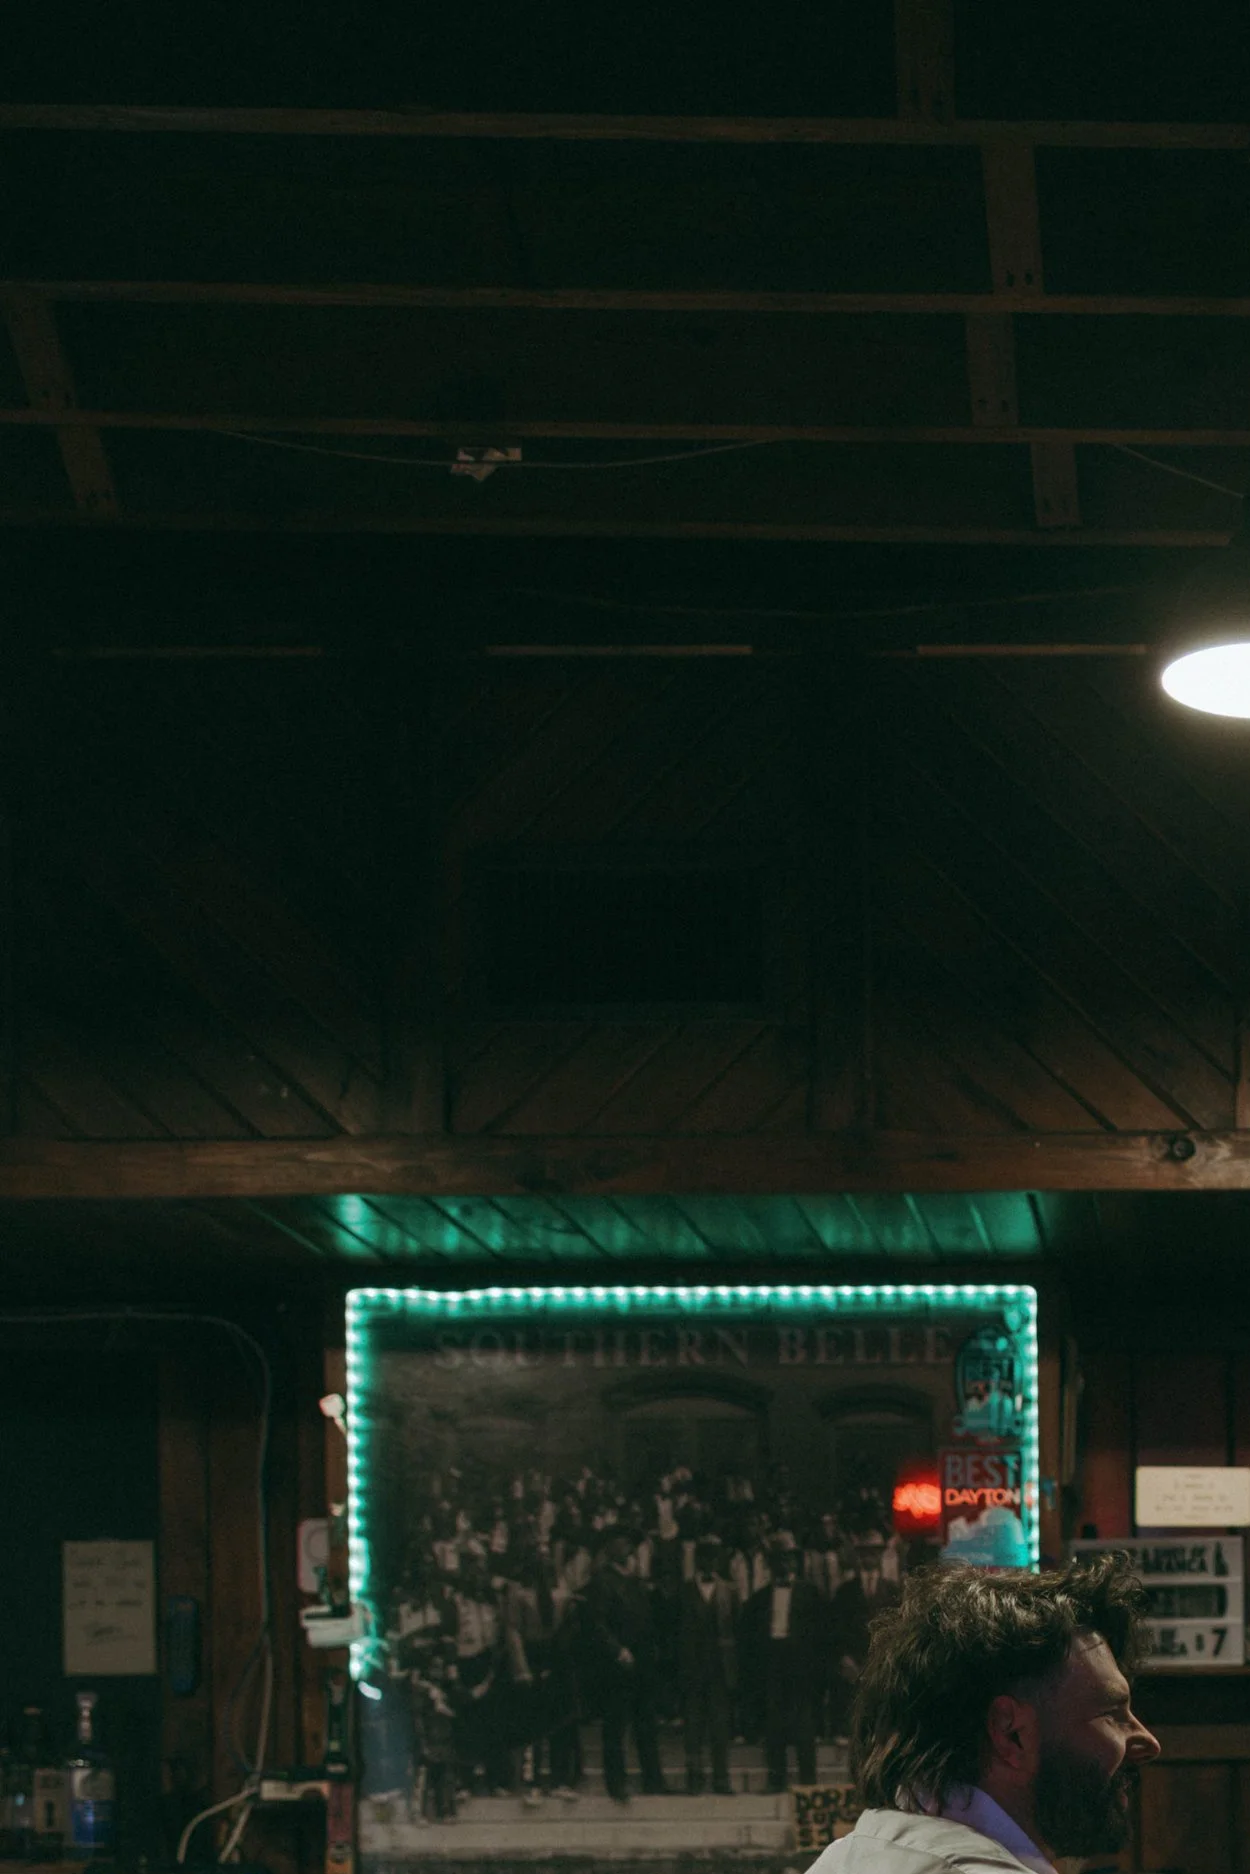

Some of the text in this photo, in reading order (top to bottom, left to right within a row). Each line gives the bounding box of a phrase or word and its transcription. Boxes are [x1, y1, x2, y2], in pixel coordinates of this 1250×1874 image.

[434, 1326, 955, 1371] SOUTHERN BELLE
[944, 1454, 1019, 1488] BEST
[944, 1488, 1021, 1507] DAYTON
